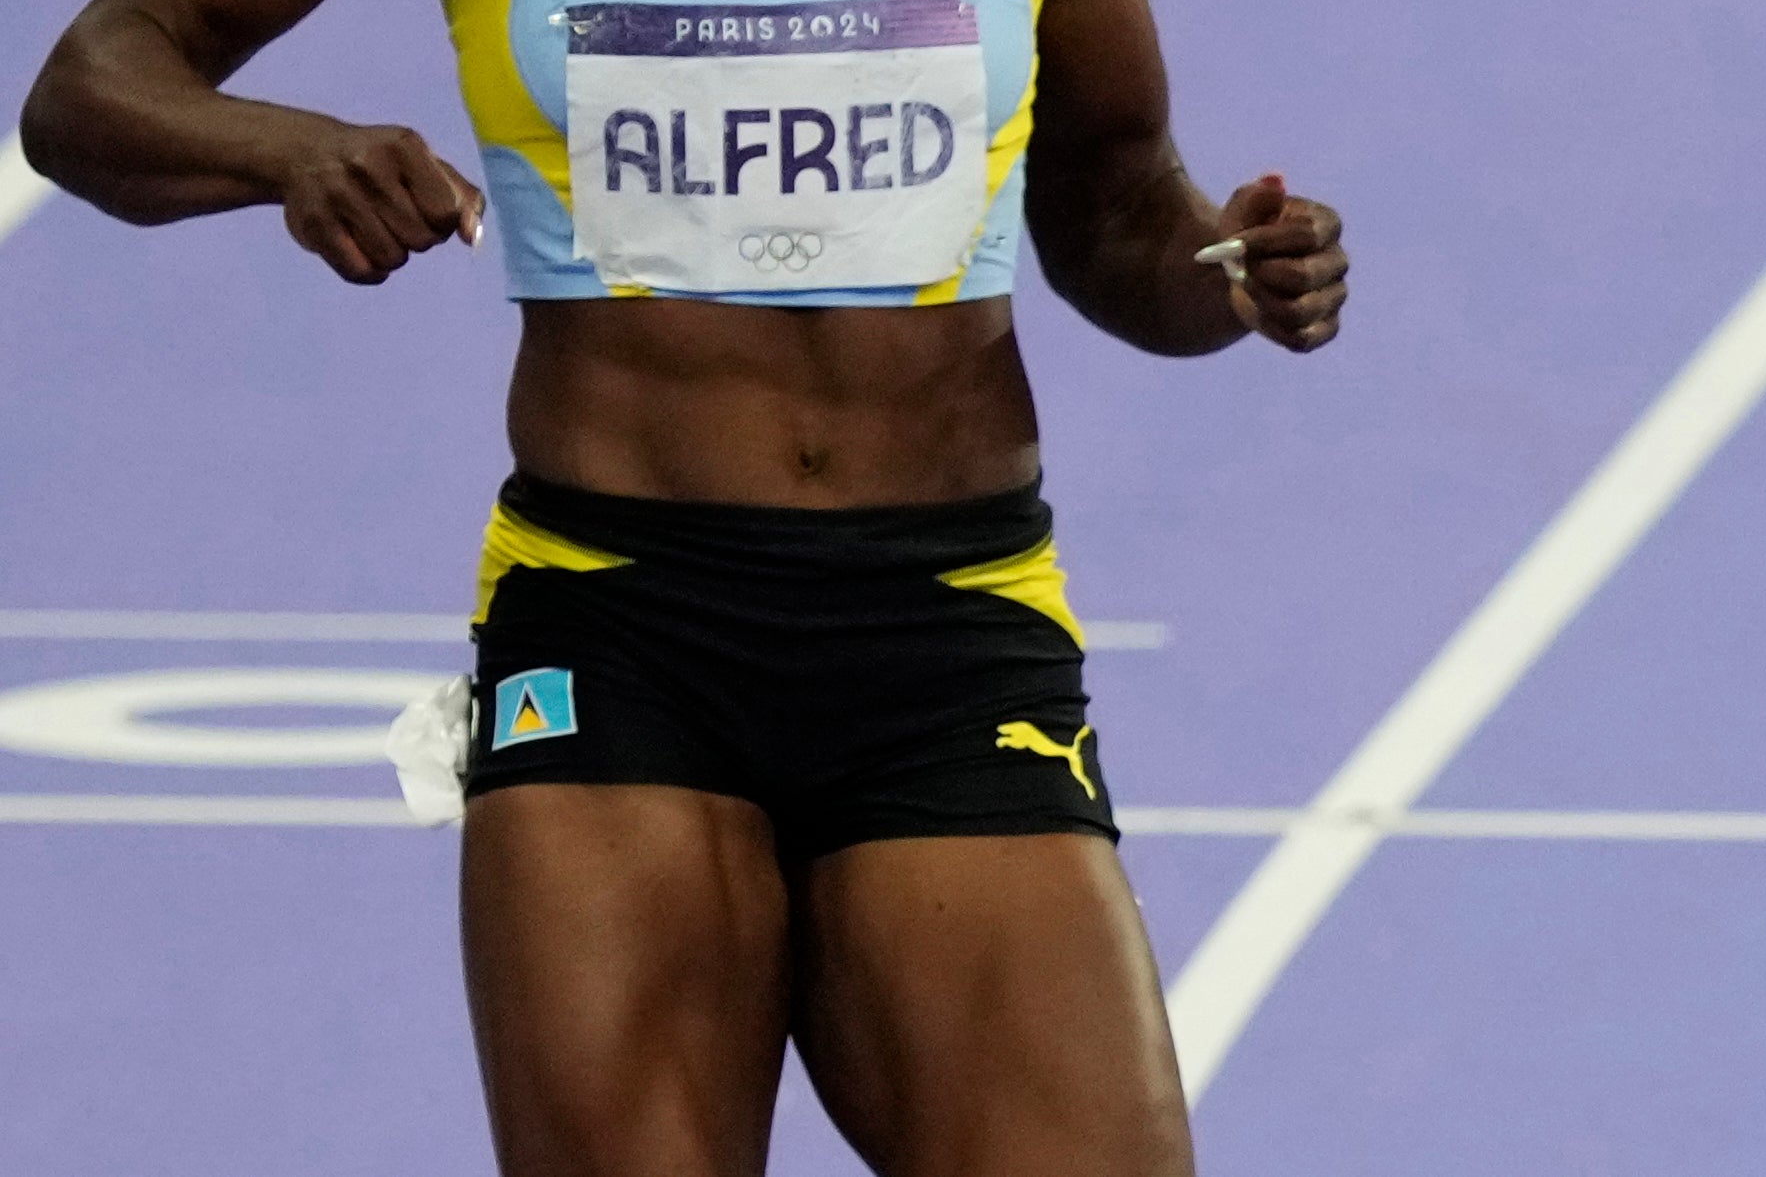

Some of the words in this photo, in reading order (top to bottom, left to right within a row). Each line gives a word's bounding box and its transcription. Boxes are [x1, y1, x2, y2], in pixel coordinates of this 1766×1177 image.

[675, 17, 775, 42] PARIS
[788, 12, 881, 40] 2024
[604, 101, 955, 196] ALFRED
